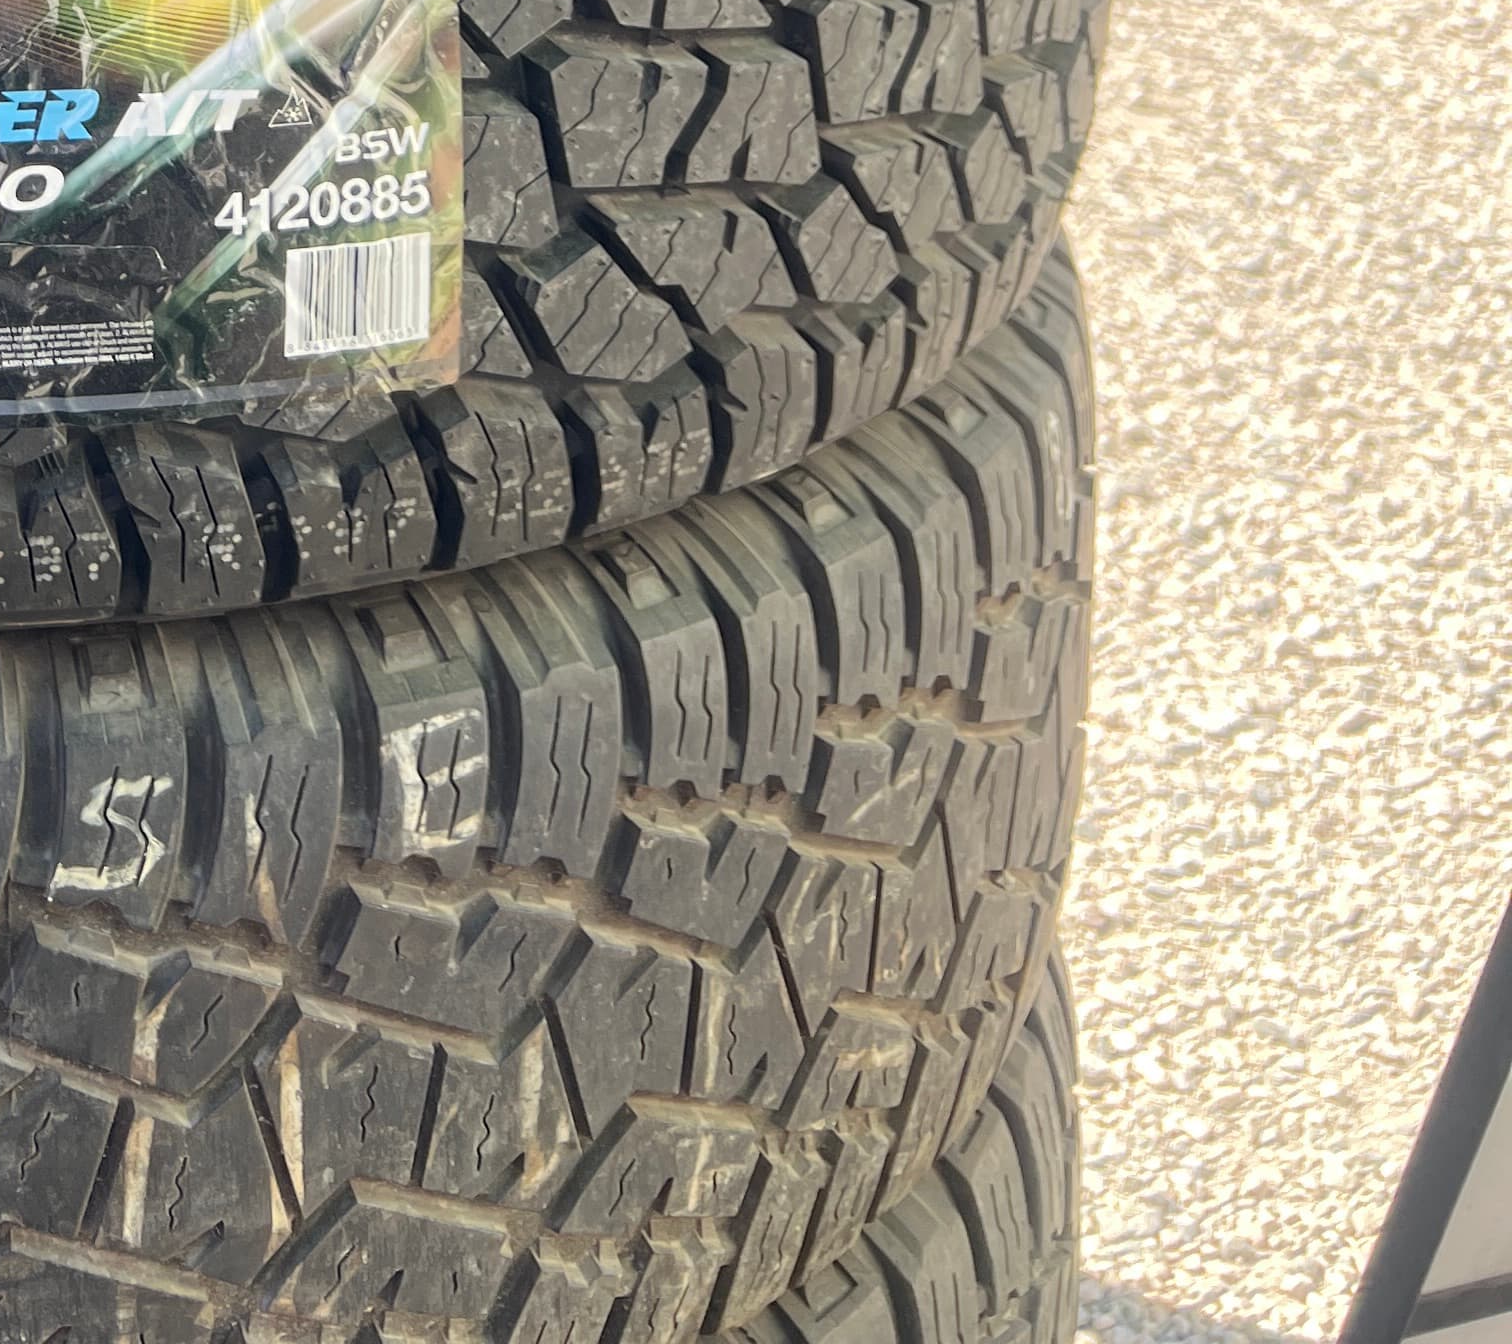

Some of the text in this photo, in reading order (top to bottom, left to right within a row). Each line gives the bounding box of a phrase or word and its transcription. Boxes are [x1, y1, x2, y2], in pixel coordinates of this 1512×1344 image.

[112, 89, 260, 139] A/T
[334, 122, 429, 165] BSW
[214, 173, 431, 237] 4120885
